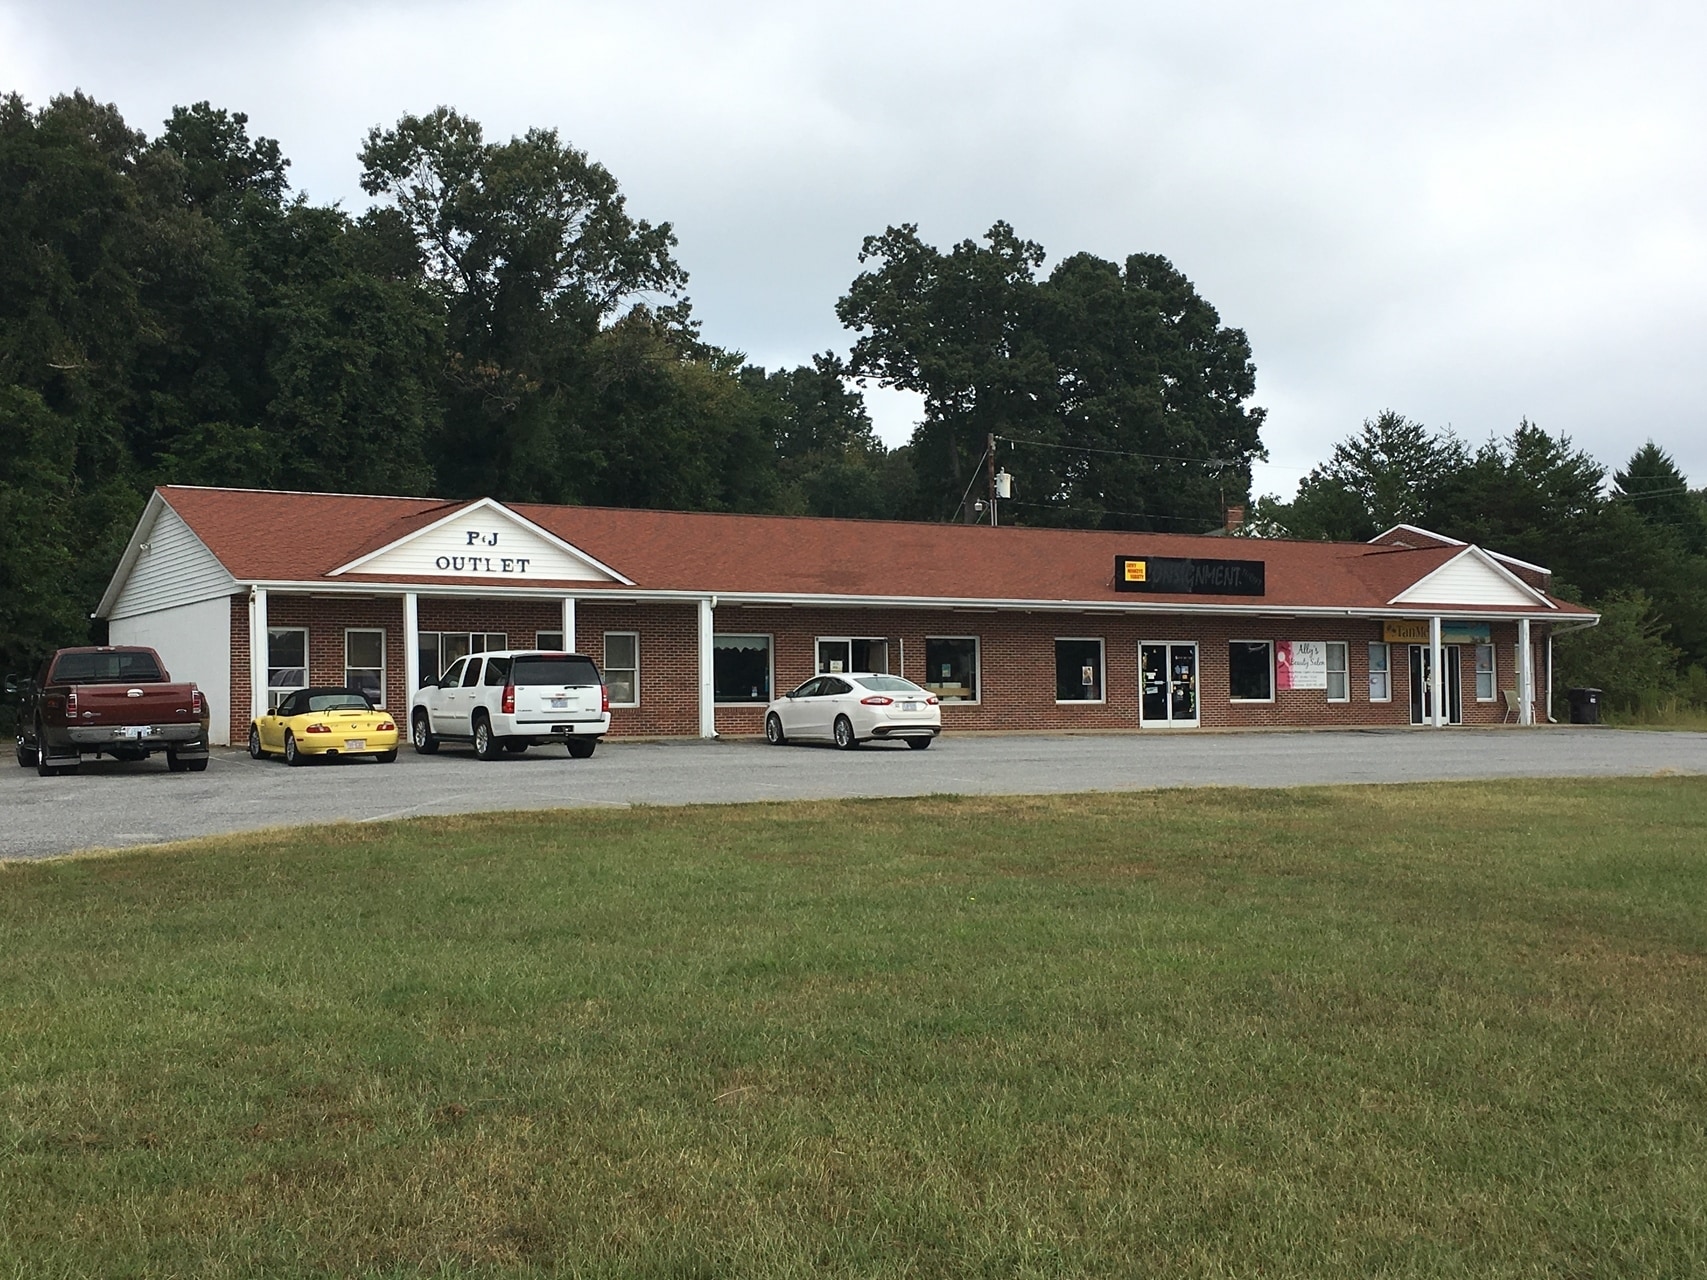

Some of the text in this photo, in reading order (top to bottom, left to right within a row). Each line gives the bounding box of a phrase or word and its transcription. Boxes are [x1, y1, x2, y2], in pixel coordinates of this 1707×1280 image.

[436, 556, 530, 573] OUTLET
[1296, 643, 1319, 658] Ally's
[1310, 657, 1325, 666] Salon
